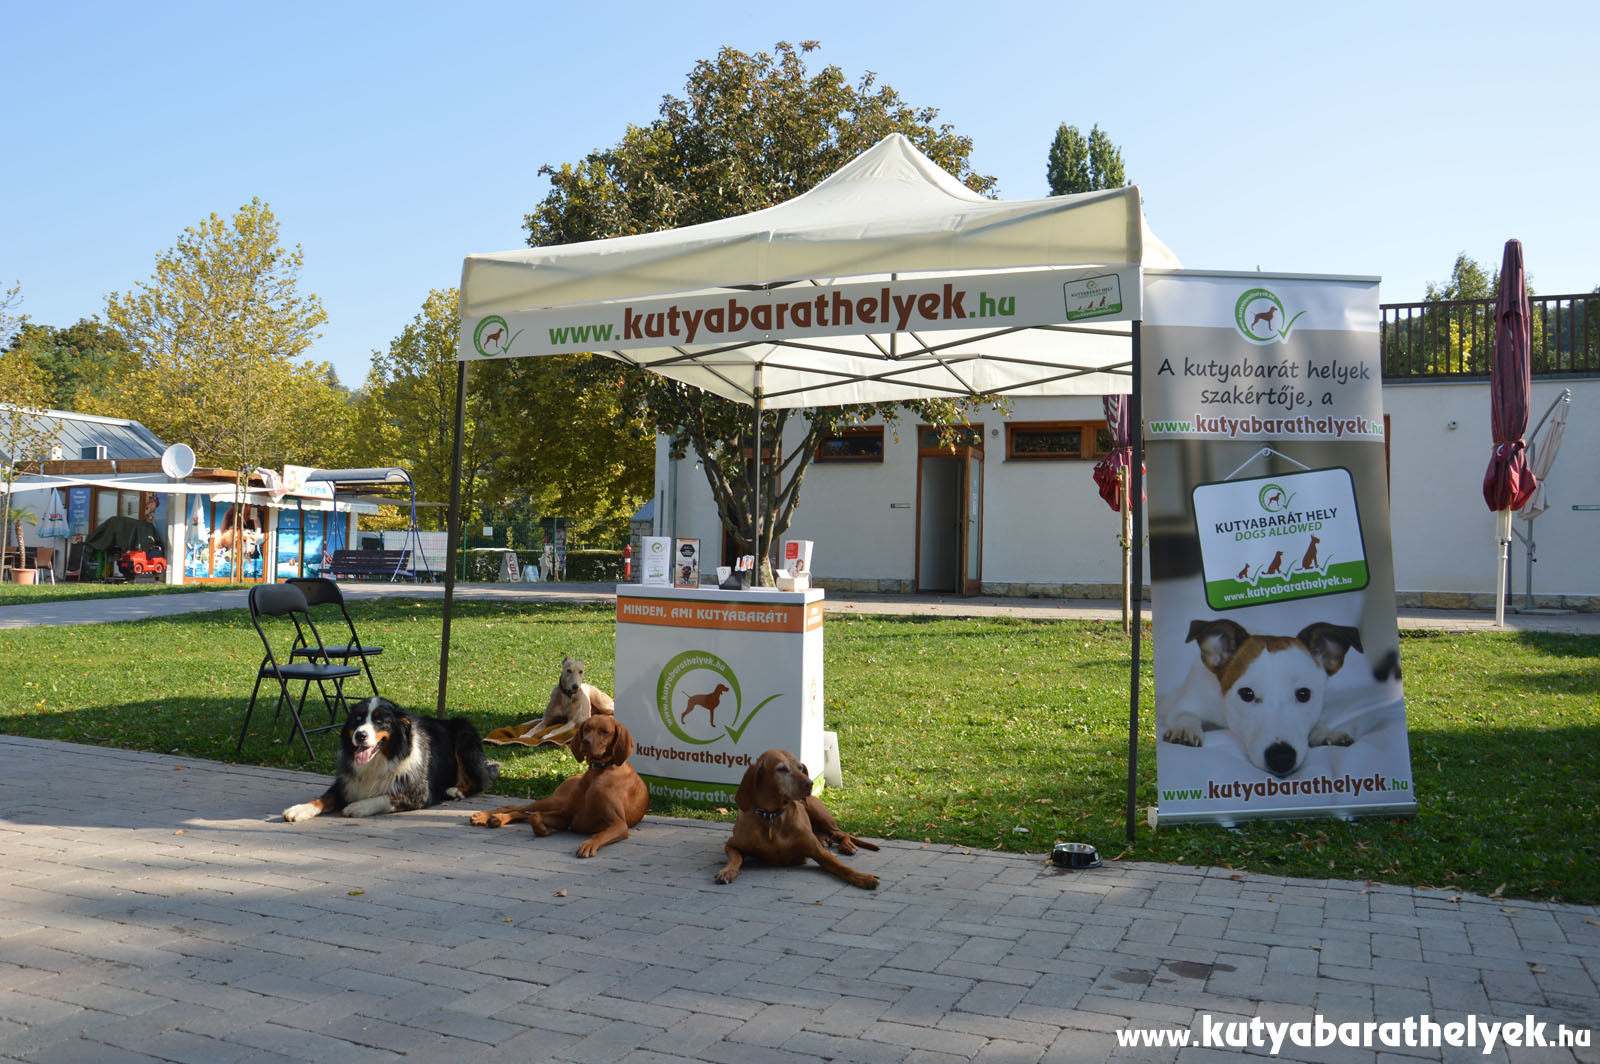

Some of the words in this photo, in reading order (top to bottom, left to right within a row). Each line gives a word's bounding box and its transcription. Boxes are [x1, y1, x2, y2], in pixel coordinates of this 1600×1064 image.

[549, 284, 1016, 343] www.kutyabarathelyek.hu
[1157, 358, 1175, 376] A
[1184, 357, 1299, 383] kutyabarát
[1307, 360, 1371, 385] helyek
[1201, 385, 1313, 410] szakértője,
[1321, 392, 1333, 405] a
[1150, 414, 1384, 437] www.kutyabarathelyek.hu
[1215, 511, 1303, 534] KUTYABARÁT
[1306, 507, 1338, 522] HELY
[1235, 529, 1266, 541] DOGS
[1269, 521, 1322, 537] ALLOWED
[1224, 576, 1352, 602] www.kutyabarathelyek.hu
[623, 604, 667, 618] MINDEN,
[671, 607, 693, 619] AMI
[636, 743, 753, 768] kutyabarathelyek
[1163, 774, 1409, 802] www.kutyabarathelyek.hu
